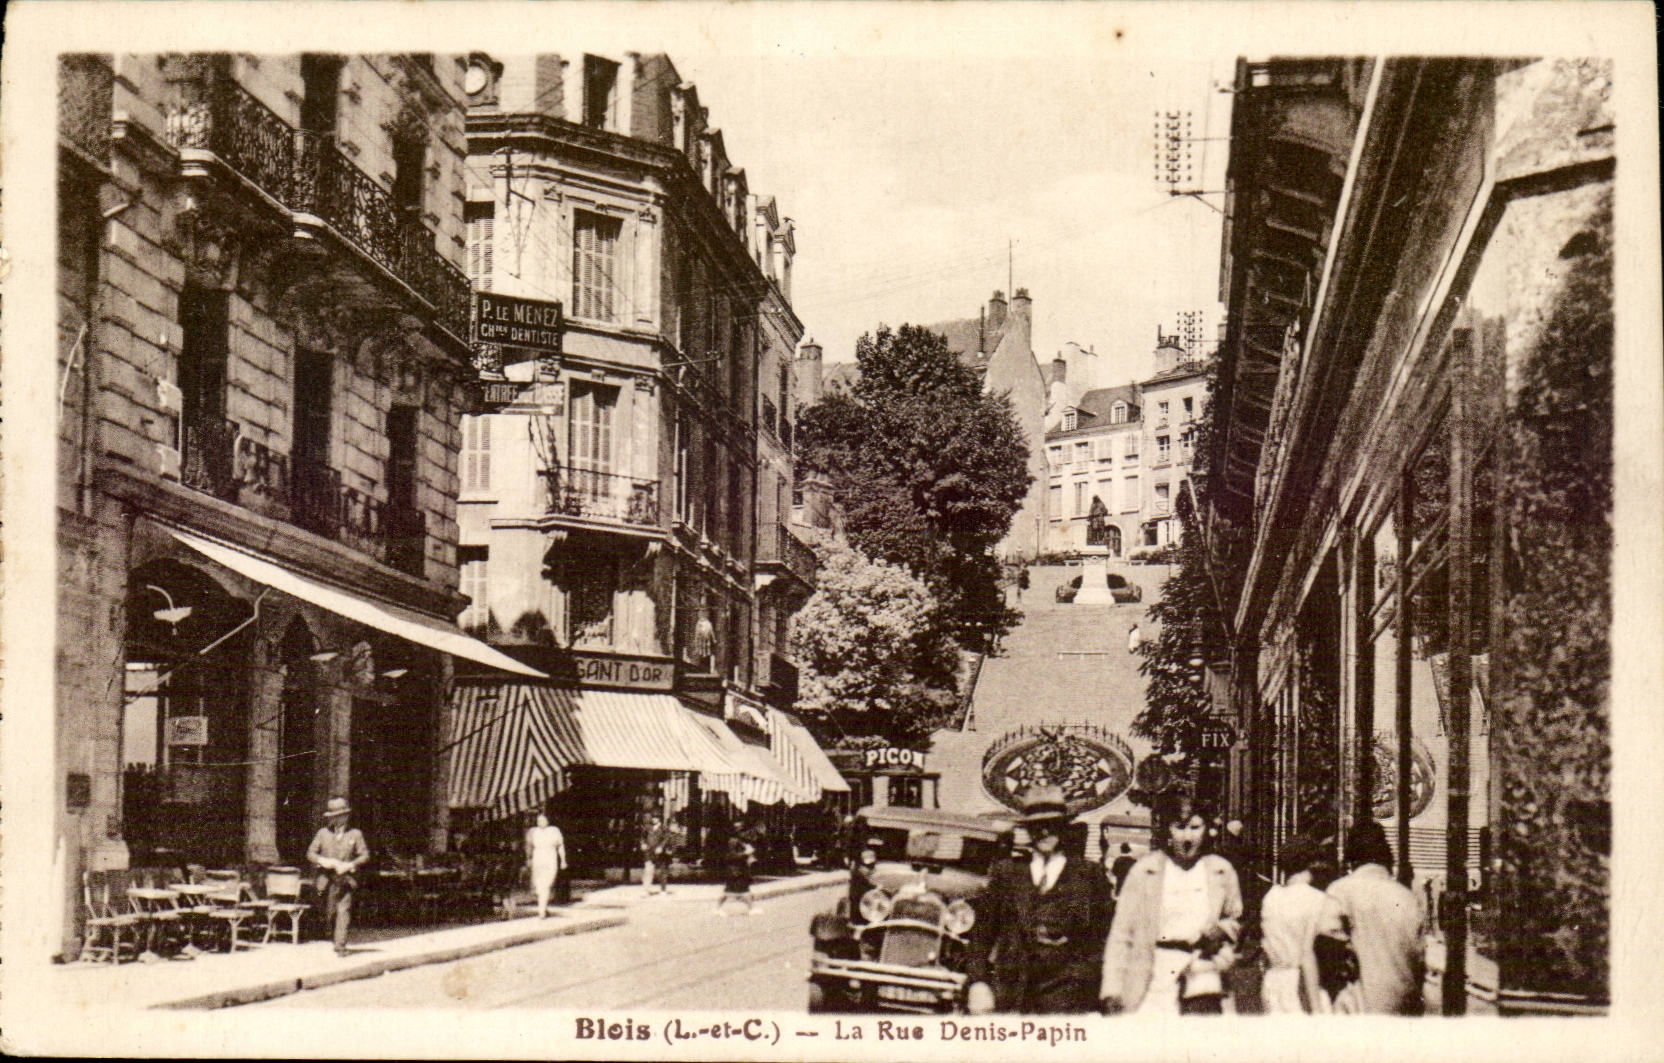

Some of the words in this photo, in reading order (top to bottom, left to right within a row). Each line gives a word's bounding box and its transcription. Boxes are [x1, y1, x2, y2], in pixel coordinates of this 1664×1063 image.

[483, 299, 493, 319] P.
[495, 305, 509, 321] LE
[513, 303, 558, 328] MENEZ
[511, 327, 559, 346] DENTISTE
[1201, 733, 1229, 748] FIX
